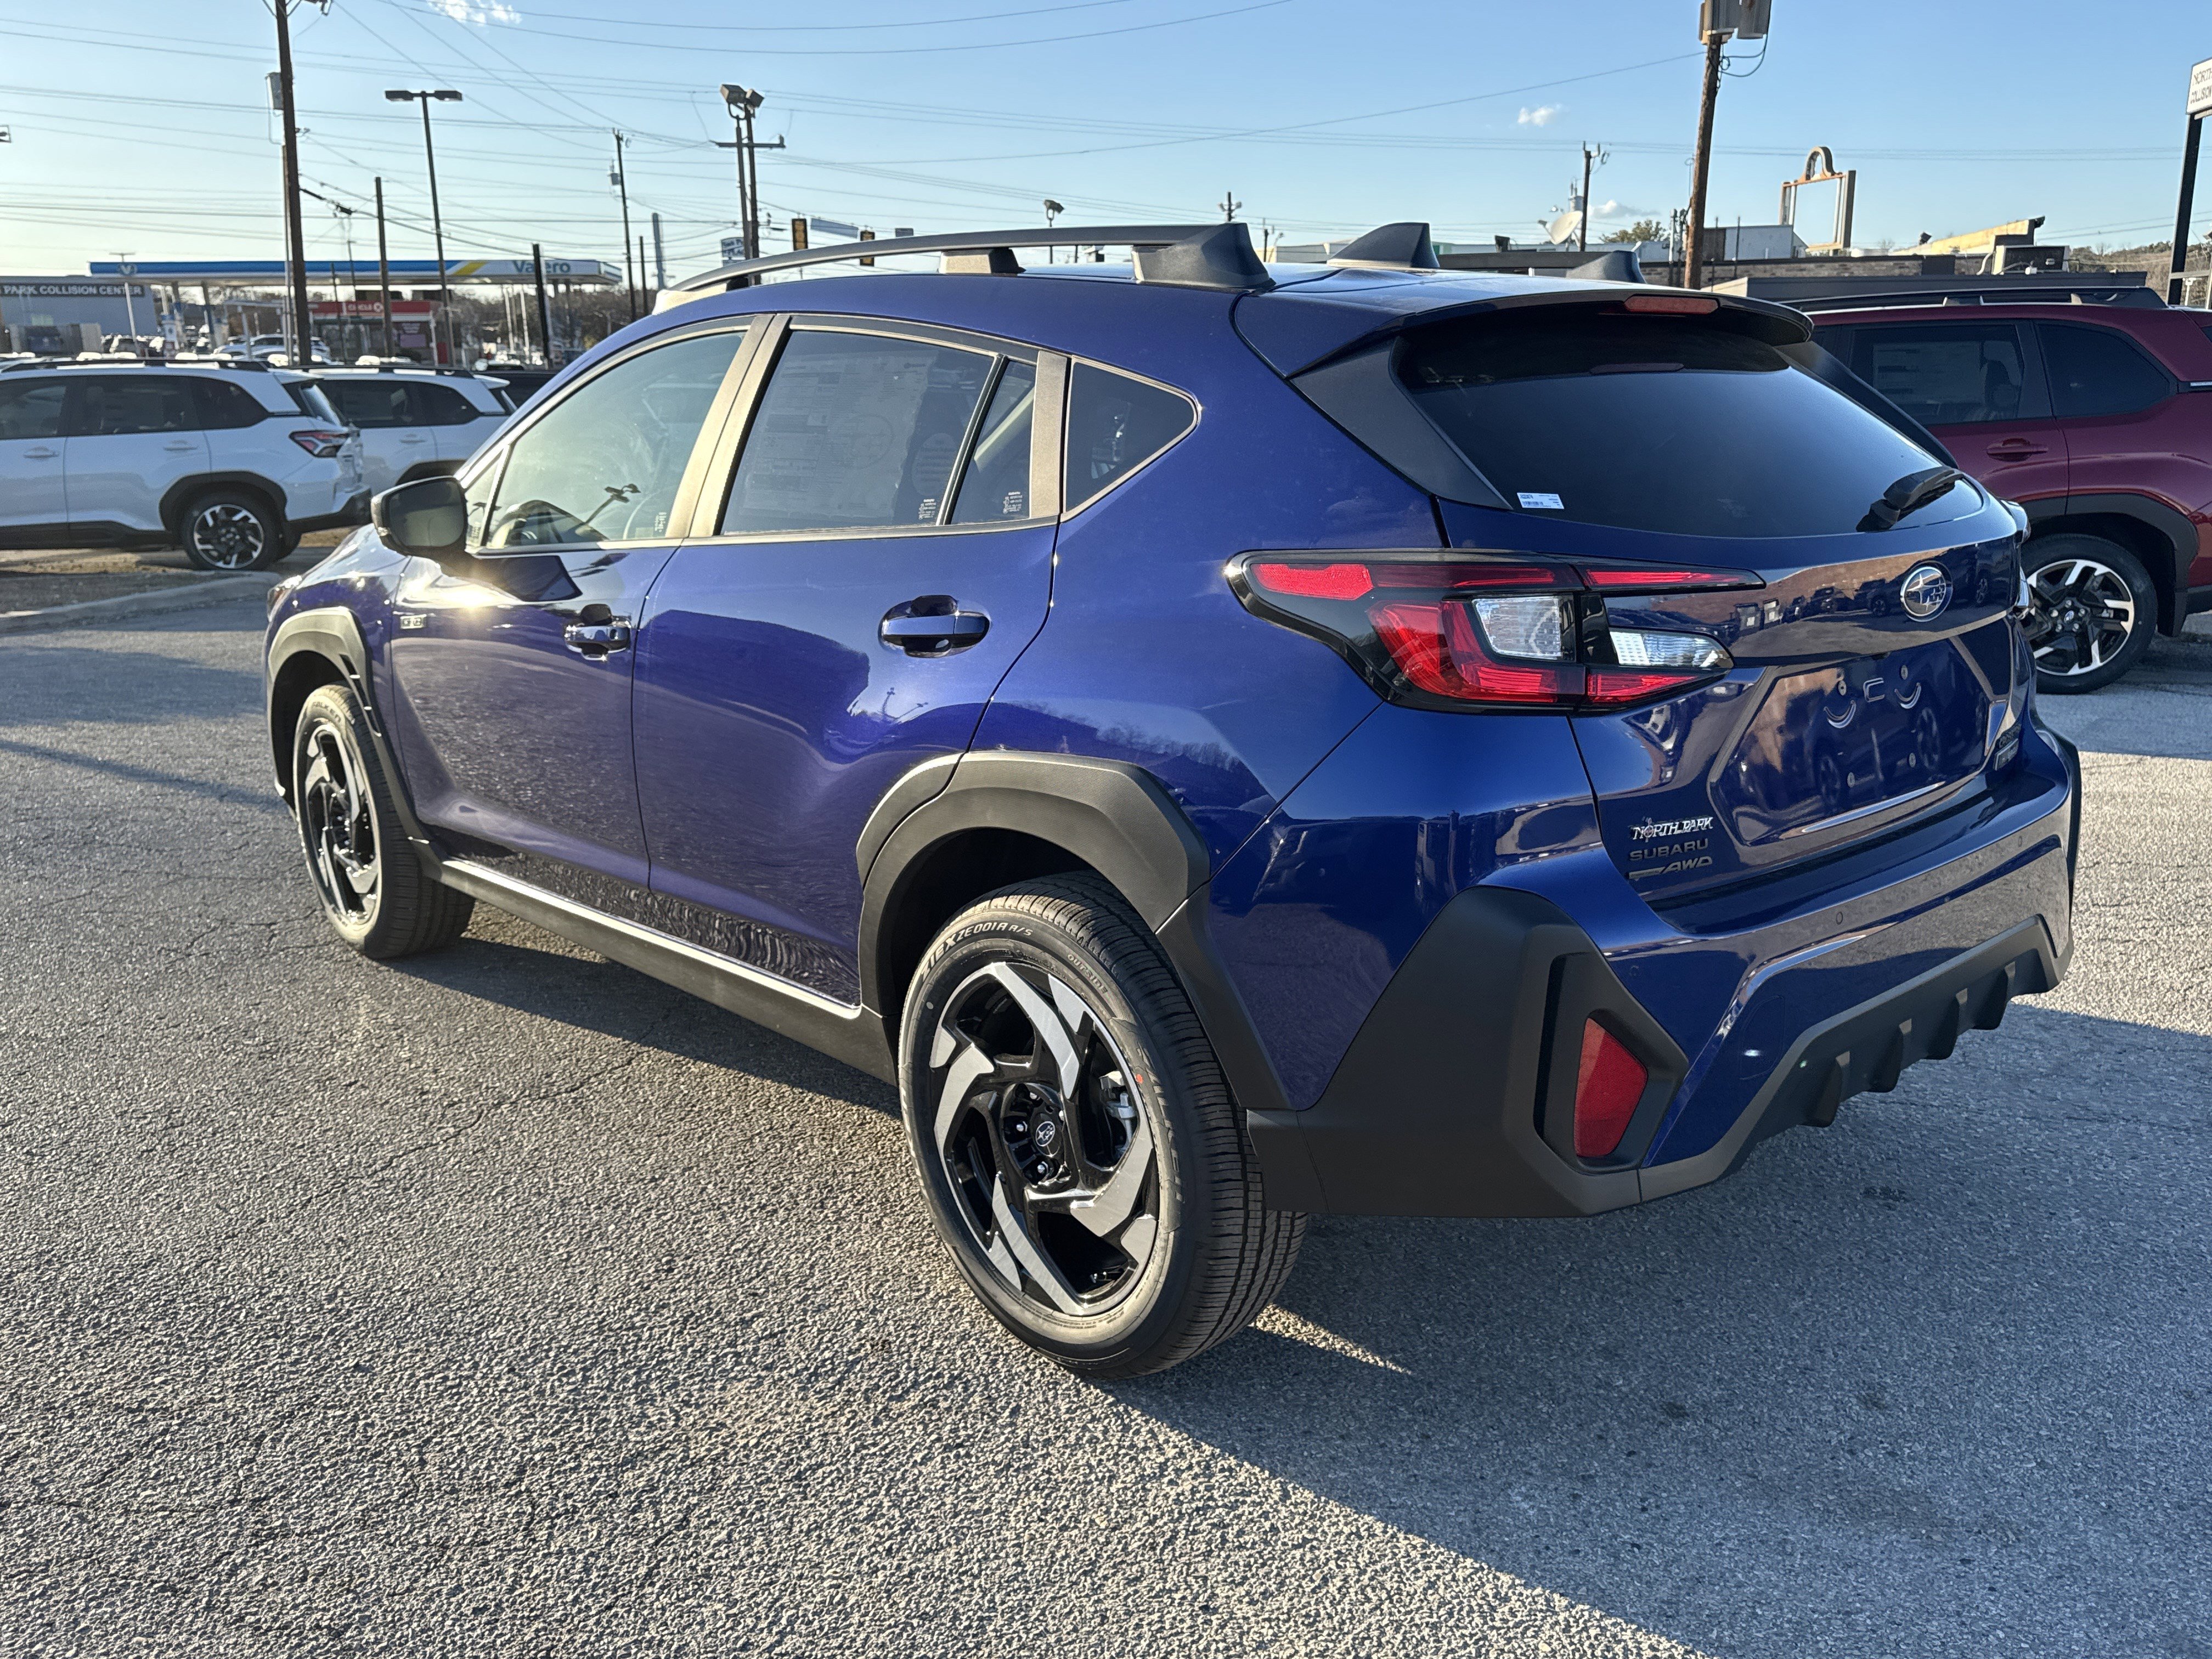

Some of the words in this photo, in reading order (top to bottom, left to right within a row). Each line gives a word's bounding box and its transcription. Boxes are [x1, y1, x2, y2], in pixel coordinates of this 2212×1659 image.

[511, 260, 570, 273] Vaero
[39, 285, 97, 295] COLLISION
[1631, 817, 1679, 843] NORTH
[1680, 816, 1713, 833] PARK
[1629, 838, 1708, 861] SUBARU
[1067, 953, 1108, 994] OUTSIDE
